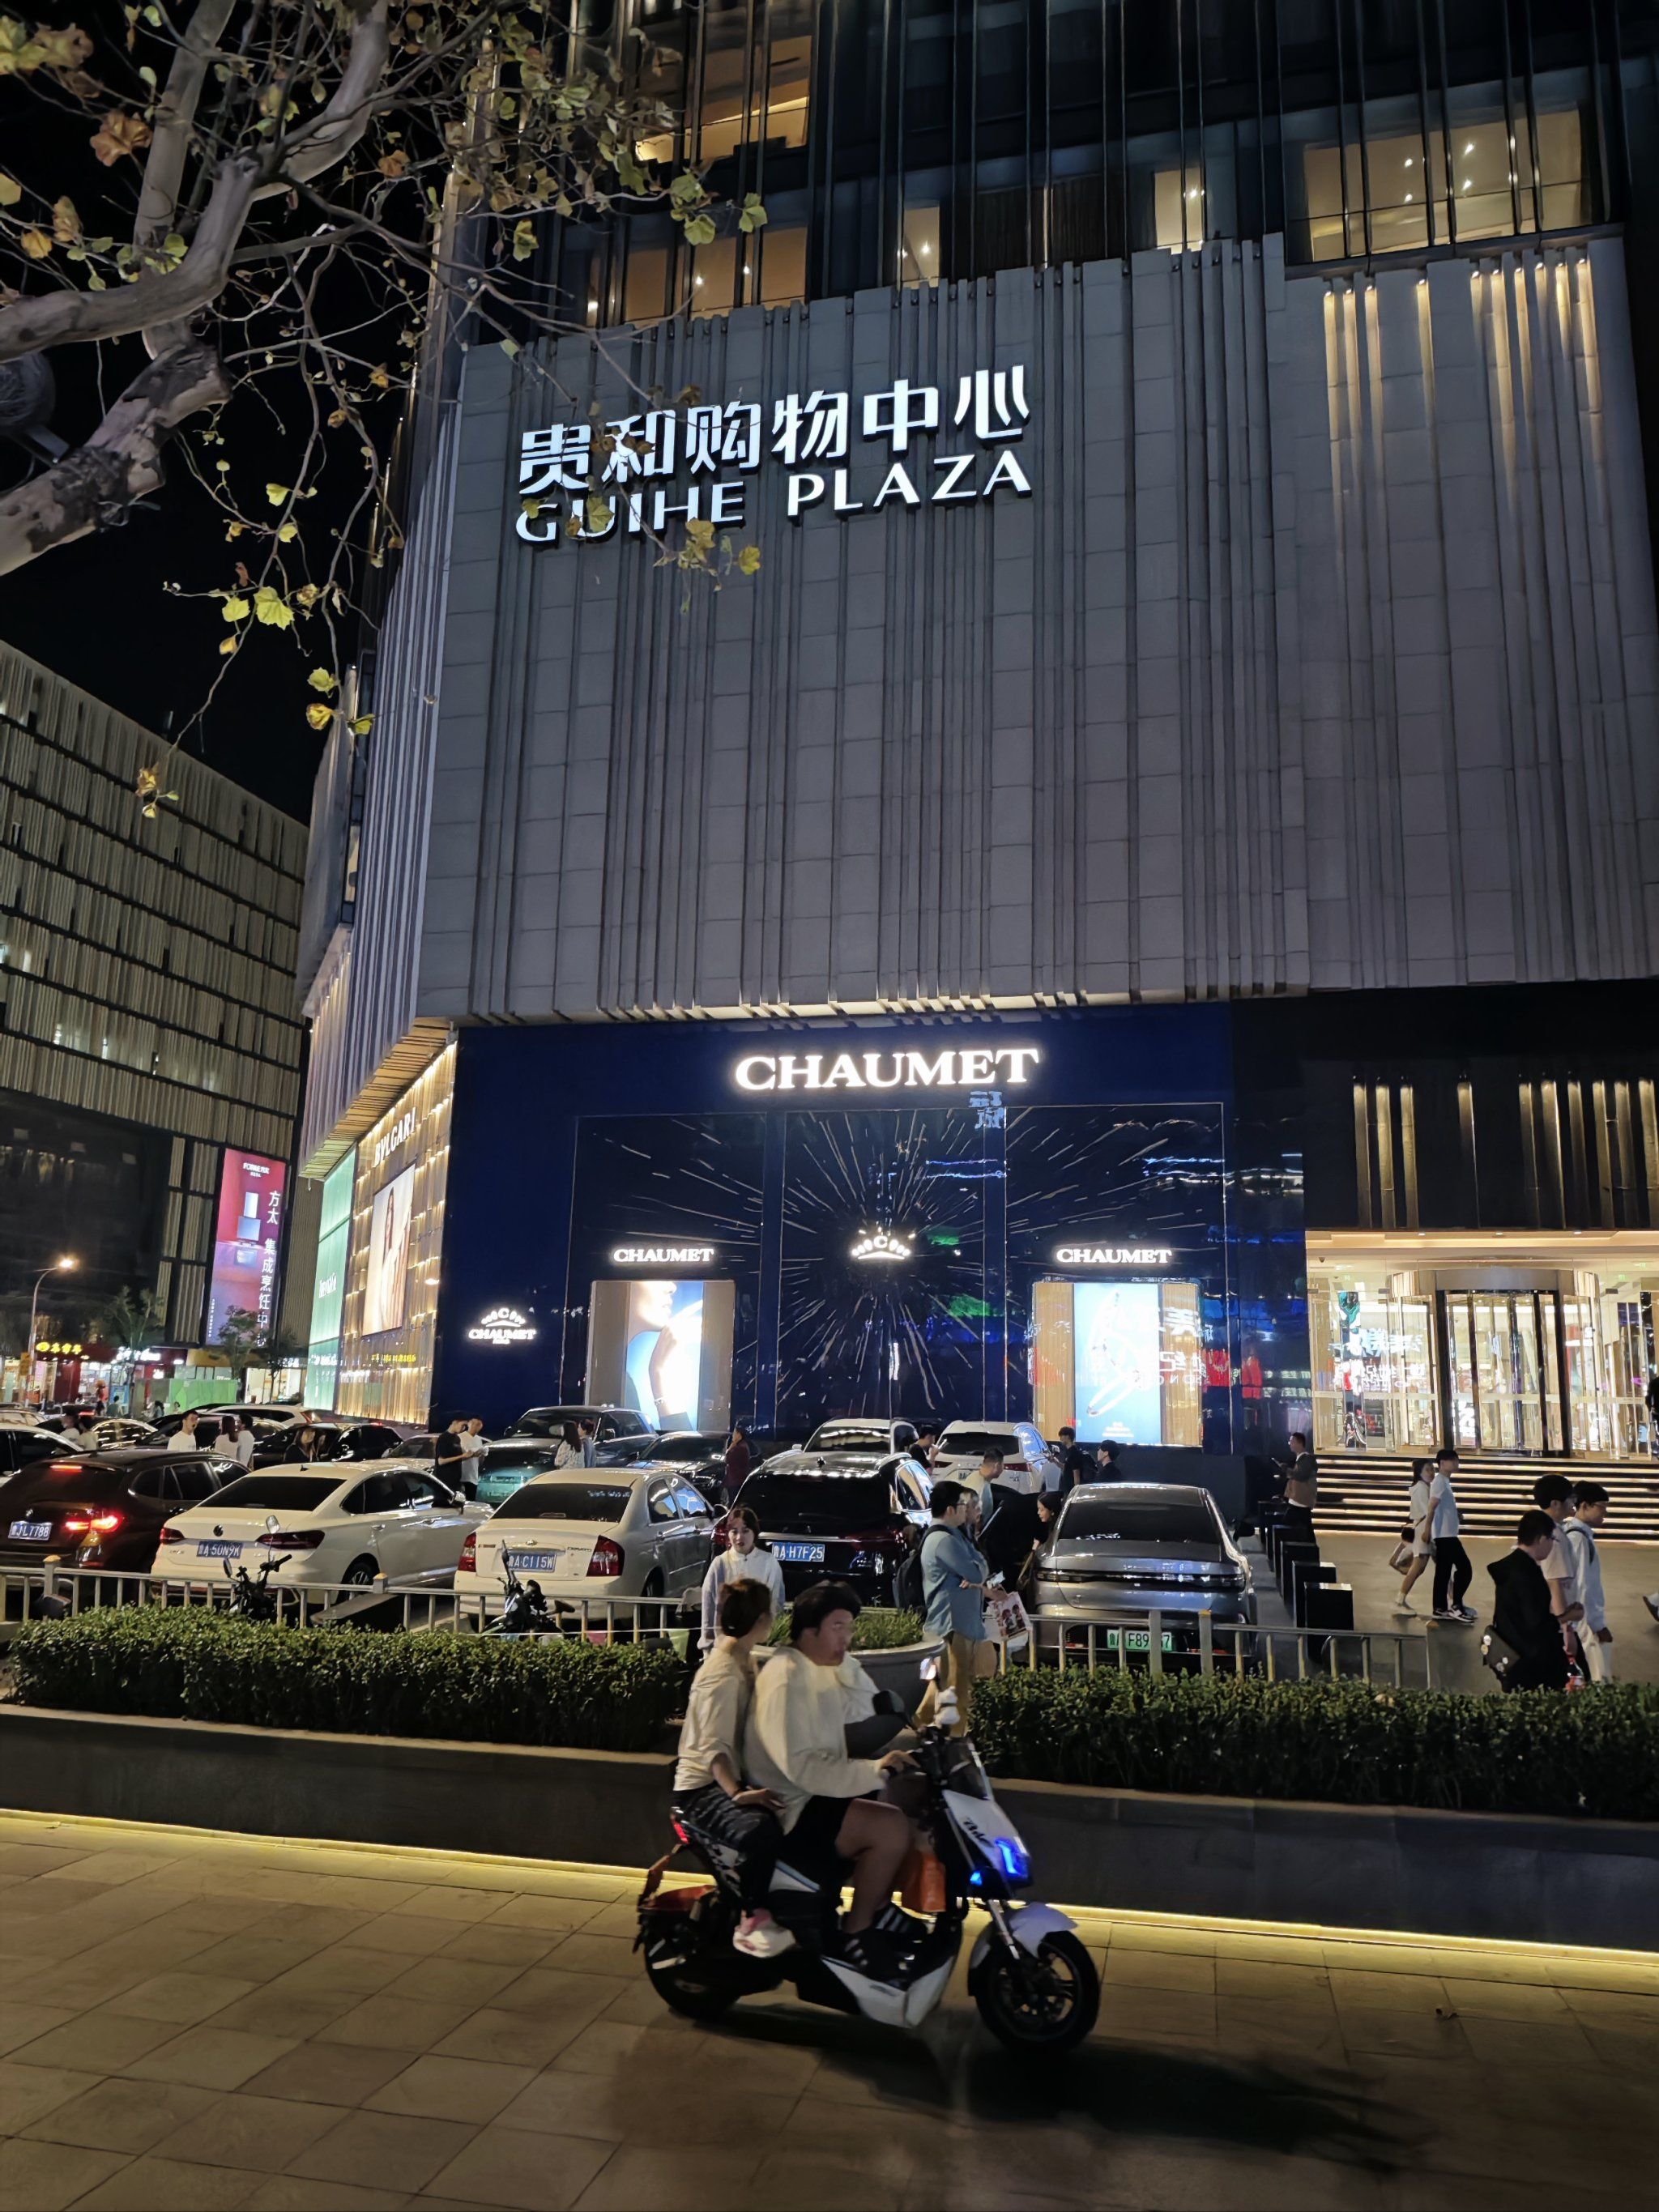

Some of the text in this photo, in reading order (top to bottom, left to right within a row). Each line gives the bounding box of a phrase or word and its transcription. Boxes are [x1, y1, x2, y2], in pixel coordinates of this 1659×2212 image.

[519, 364, 1030, 495] 贵和购物中心
[515, 450, 1032, 543] GUIHE PLAZA
[736, 1049, 1039, 1090] CHAUMET
[372, 1106, 416, 1168] BVLGARI
[267, 1190, 282, 1225] 方太
[613, 1248, 714, 1264] CHAUMET
[1056, 1248, 1172, 1264] CHAUMET
[468, 1328, 537, 1340] CHAUMET
